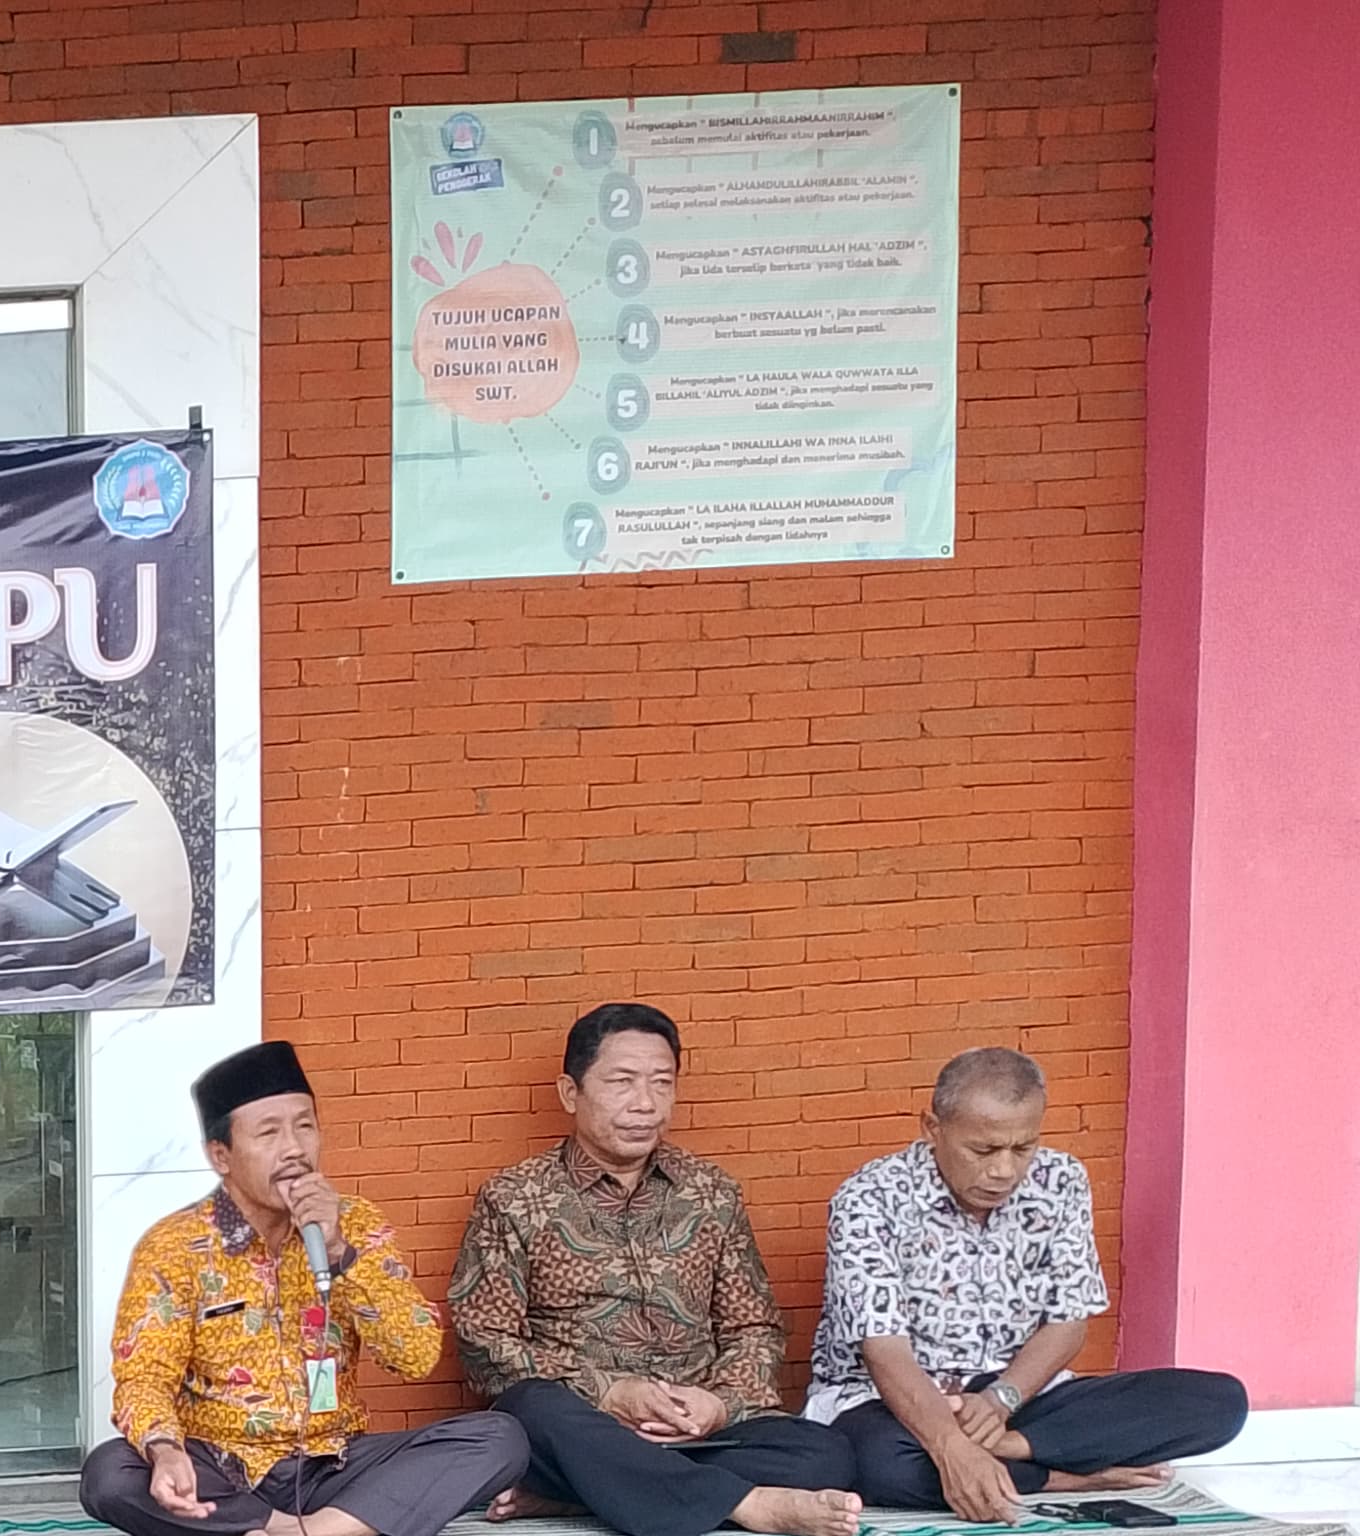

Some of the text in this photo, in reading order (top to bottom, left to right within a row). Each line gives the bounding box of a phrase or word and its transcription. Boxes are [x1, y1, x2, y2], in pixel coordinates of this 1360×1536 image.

[625, 119, 697, 132] Mengucapkan
[589, 127, 599, 157] 1
[610, 187, 630, 218] 2
[655, 248, 730, 261] Mengucapkan
[617, 254, 638, 285] 3
[817, 260, 843, 272] yang
[846, 257, 874, 268] tidak
[432, 306, 561, 326] TUJUH UCAPAN
[663, 313, 738, 326] Mengucapkan
[445, 332, 548, 351] MULIA YANG
[627, 321, 650, 351] 4
[433, 358, 559, 378] DISUKAI ALLAH
[745, 372, 760, 383] LA
[801, 369, 833, 380] WALA
[475, 386, 517, 401] SWT.
[616, 389, 638, 418] 5
[647, 442, 721, 456] Mengucapkan
[804, 436, 826, 447] WA
[828, 435, 857, 446] INNA
[597, 451, 620, 481] 6
[780, 454, 801, 464] dan
[615, 506, 686, 519] Mengucapkan
[695, 504, 711, 514] LA
[713, 502, 747, 513] ILAHA
[573, 518, 594, 548] 7
[617, 520, 690, 533] RASULULLAH
[787, 515, 807, 526] dan
